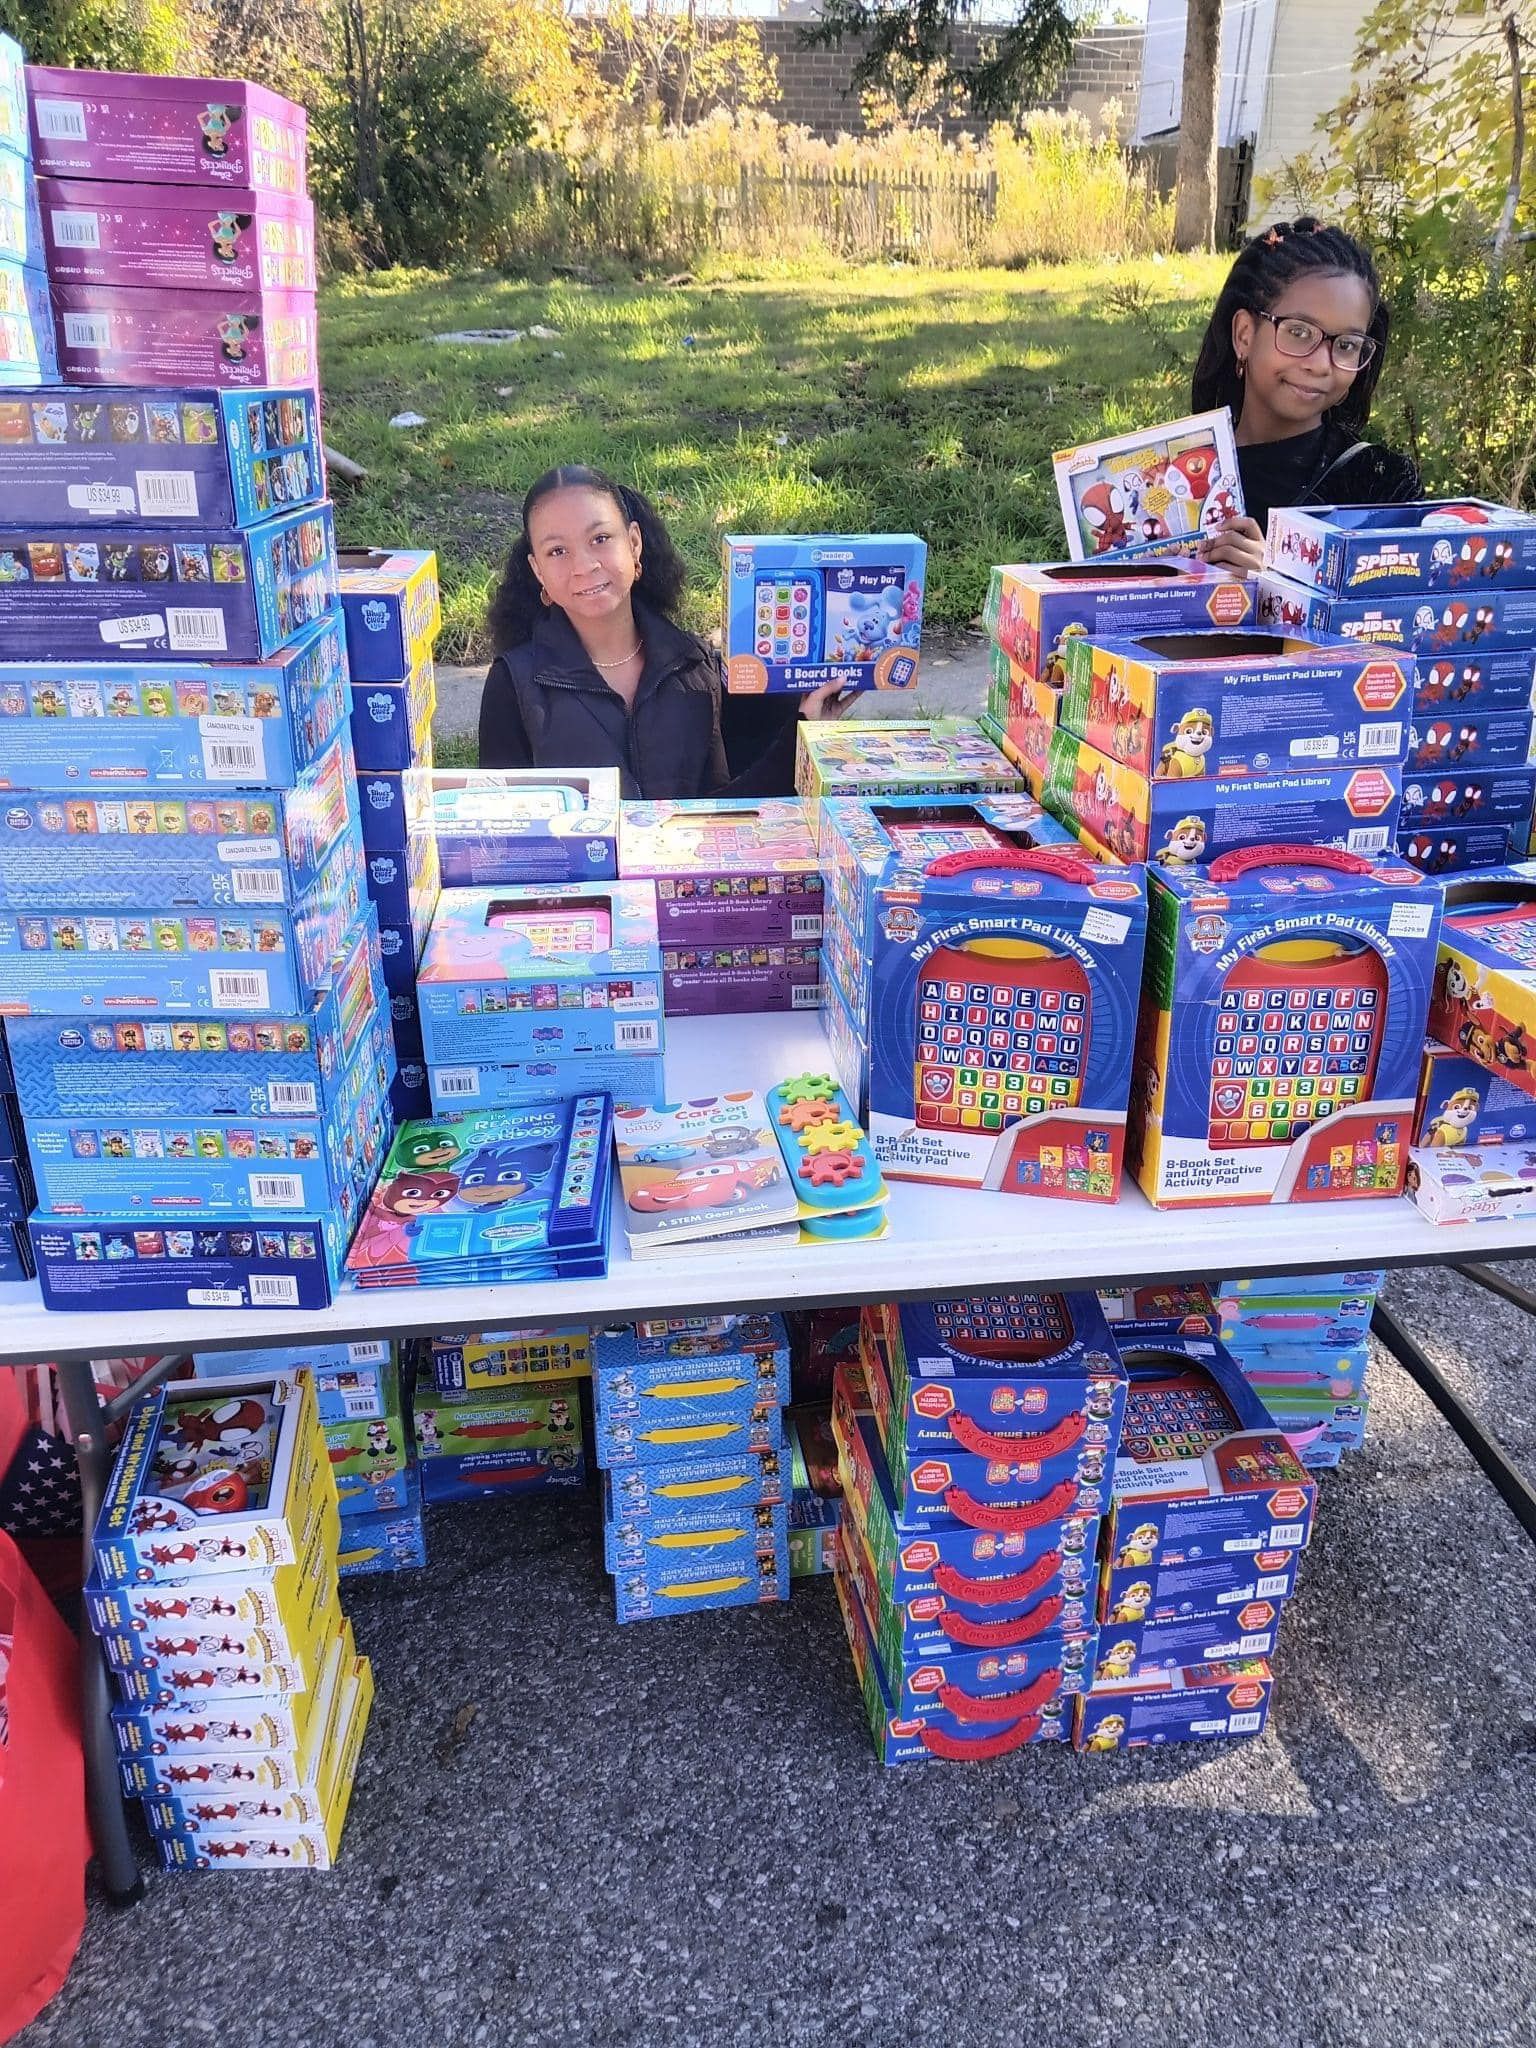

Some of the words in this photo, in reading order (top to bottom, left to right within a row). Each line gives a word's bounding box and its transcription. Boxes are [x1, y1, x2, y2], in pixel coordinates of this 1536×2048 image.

[87, 488, 96, 502] US
[1355, 553, 1419, 573] SPIDEY
[860, 575, 878, 586] Play
[881, 575, 897, 588] Day
[1097, 595, 1108, 604] My
[1109, 594, 1126, 602] First
[1128, 593, 1151, 601] Smart
[1169, 590, 1196, 600] Library
[118, 620, 128, 634] US
[1341, 619, 1402, 636] SPIDEY
[785, 668, 791, 678] 8
[795, 668, 828, 678] Board
[831, 666, 862, 677] Books
[1224, 675, 1237, 685] My
[1240, 674, 1260, 683] First
[1263, 672, 1290, 682] Smart
[1293, 671, 1310, 680] Pad
[1311, 668, 1342, 680] Library
[1342, 748, 1354, 758] CE
[910, 942, 933, 962] My
[931, 922, 966, 942] First
[968, 918, 1018, 931] Smart
[1021, 918, 1053, 934] Pad
[1052, 927, 1099, 970] Library
[1216, 950, 1239, 971] My
[1238, 926, 1272, 949] First
[1275, 914, 1323, 931] Smart
[1326, 913, 1353, 928] Pad
[1355, 920, 1398, 959] Library
[1224, 994, 1235, 1007] A
[1248, 994, 1259, 1006] B
[1271, 994, 1282, 1006] C
[1294, 993, 1305, 1005] D
[1318, 993, 1327, 1005] E
[1341, 992, 1350, 1005] F
[1362, 991, 1373, 1004] G
[1222, 1017, 1233, 1029] H
[1246, 1017, 1255, 1029] I
[1270, 1016, 1277, 1029] J
[1291, 1016, 1302, 1028] K
[1315, 1016, 1323, 1028] L
[1334, 1015, 1350, 1028] M
[1358, 1014, 1370, 1027] N
[1220, 1040, 1230, 1051] O
[1242, 1039, 1253, 1051] P
[1264, 1038, 1276, 1052] Q
[1288, 1038, 1299, 1050] R
[1311, 1038, 1322, 1050] S
[1334, 1036, 1344, 1050] T
[1355, 1036, 1366, 1050] U
[1218, 1062, 1228, 1074] V
[1238, 1062, 1253, 1074] W
[1262, 1061, 1273, 1073] X
[1286, 1061, 1296, 1073] Y
[1308, 1060, 1318, 1072] Z
[1328, 1059, 1365, 1072] ABCs
[674, 1108, 720, 1120] Cars
[726, 1105, 746, 1114] on
[680, 1118, 707, 1129] the
[710, 1110, 750, 1124] Go!
[474, 1112, 556, 1130] READING
[467, 1124, 561, 1145] Catboy
[922, 1137, 943, 1147] Set
[900, 1145, 971, 1159] Interactive
[925, 1156, 948, 1166] Pad
[1166, 1158, 1211, 1169] 8-Book
[1214, 1157, 1235, 1167] Set
[1166, 1169, 1190, 1178] and
[1193, 1165, 1262, 1177] Interactive
[1164, 1177, 1213, 1188] Activity
[1216, 1175, 1240, 1185] Pad
[658, 1220, 668, 1228] A
[671, 1215, 702, 1226] STEM
[705, 1210, 734, 1220] Gear
[738, 1204, 770, 1214] Book
[718, 1230, 746, 1240] Gear
[749, 1227, 782, 1237] Book
[202, 1292, 210, 1302] US
[938, 1342, 977, 1365] Library
[1068, 1341, 1084, 1357] My
[979, 1360, 1004, 1369] Pad
[1006, 1360, 1045, 1369] Smart
[1045, 1350, 1069, 1366] First
[134, 1406, 158, 1429] Book
[132, 1433, 148, 1450] and
[115, 1453, 141, 1503] Wristband
[1114, 1468, 1143, 1477] -Book
[1132, 1470, 1189, 1481] Interactive
[1115, 1481, 1151, 1490] Activity
[1154, 1478, 1175, 1486] Pad
[108, 1506, 125, 1527] Set
